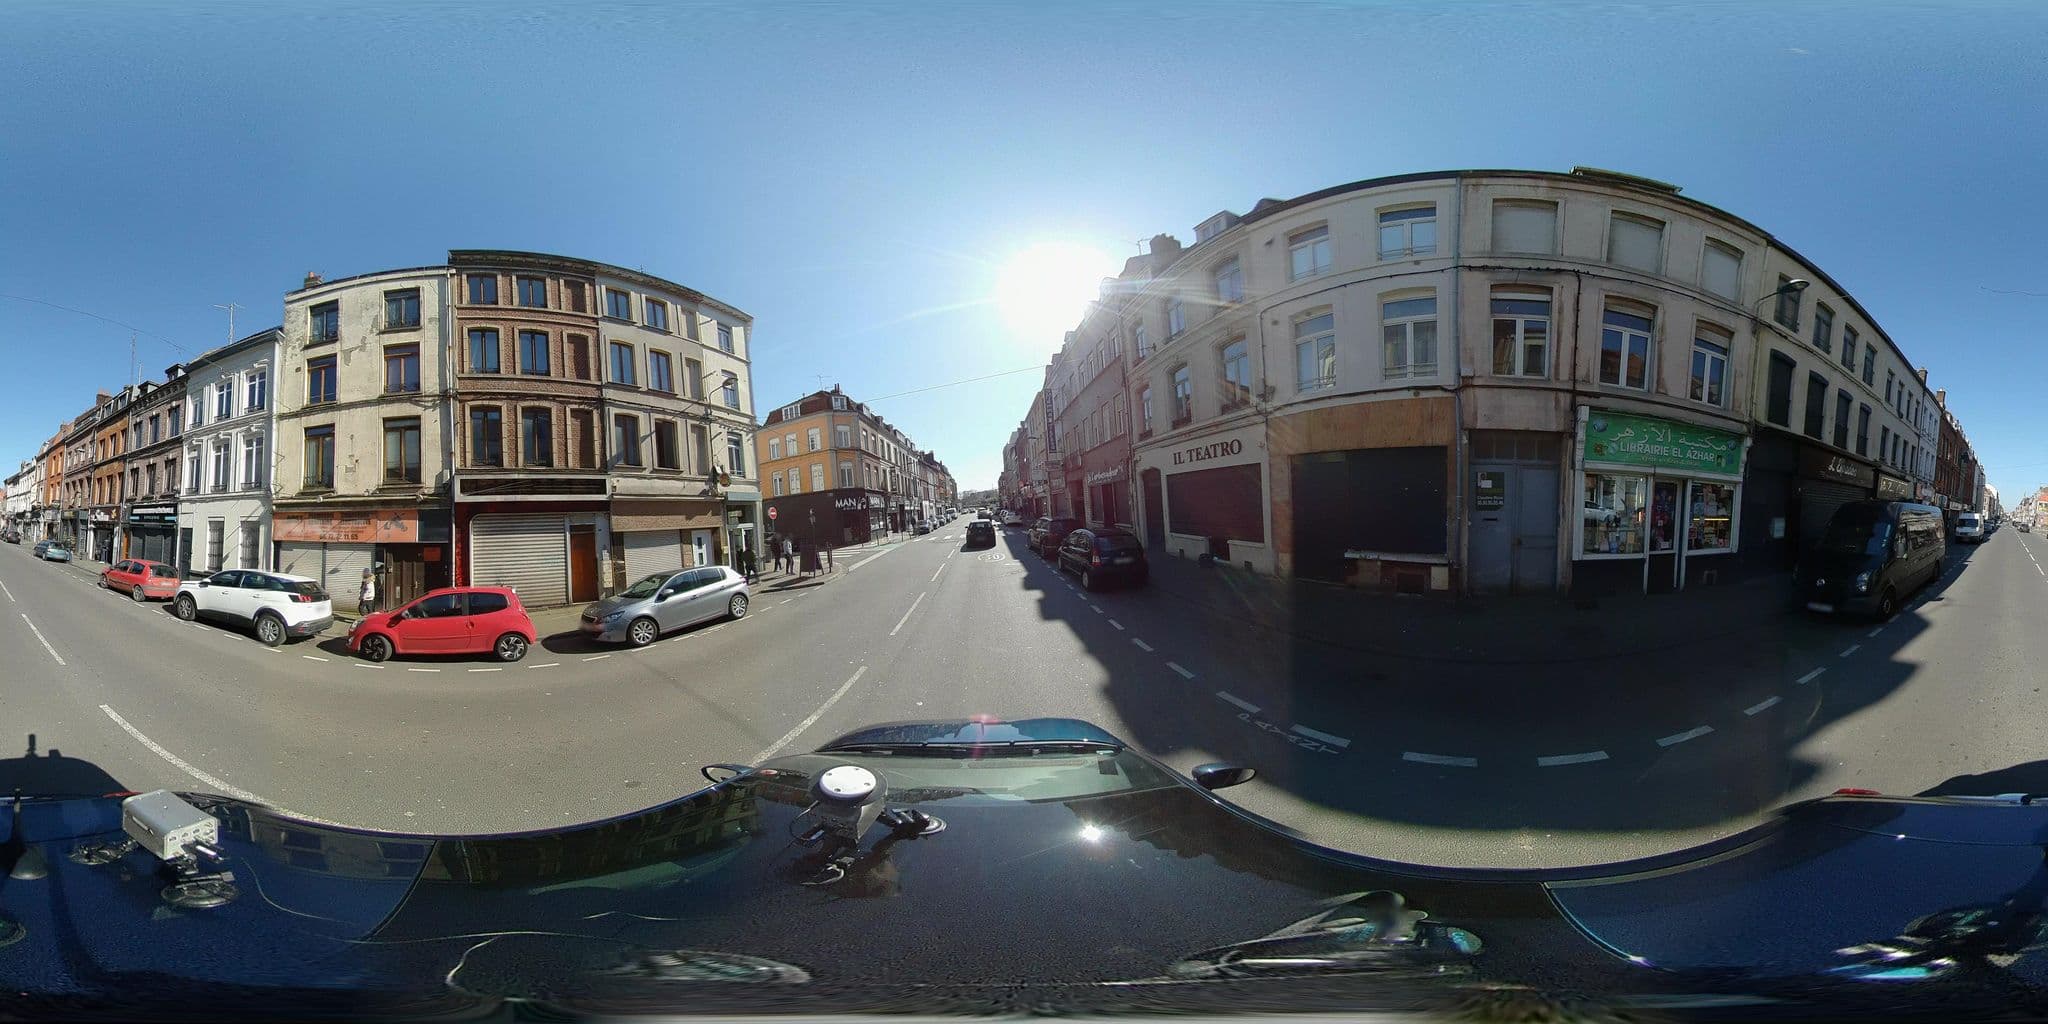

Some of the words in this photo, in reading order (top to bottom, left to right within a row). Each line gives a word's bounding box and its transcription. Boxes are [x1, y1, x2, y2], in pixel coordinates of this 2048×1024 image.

[1679, 431, 1727, 451] مكتبة
[1173, 451, 1185, 465] IL
[1186, 439, 1242, 463] TEATRO
[1620, 441, 1669, 456] LIBRAIRIE
[1672, 447, 1683, 458] EL
[1686, 449, 1715, 462] AZHAR
[835, 497, 857, 508] MAN
